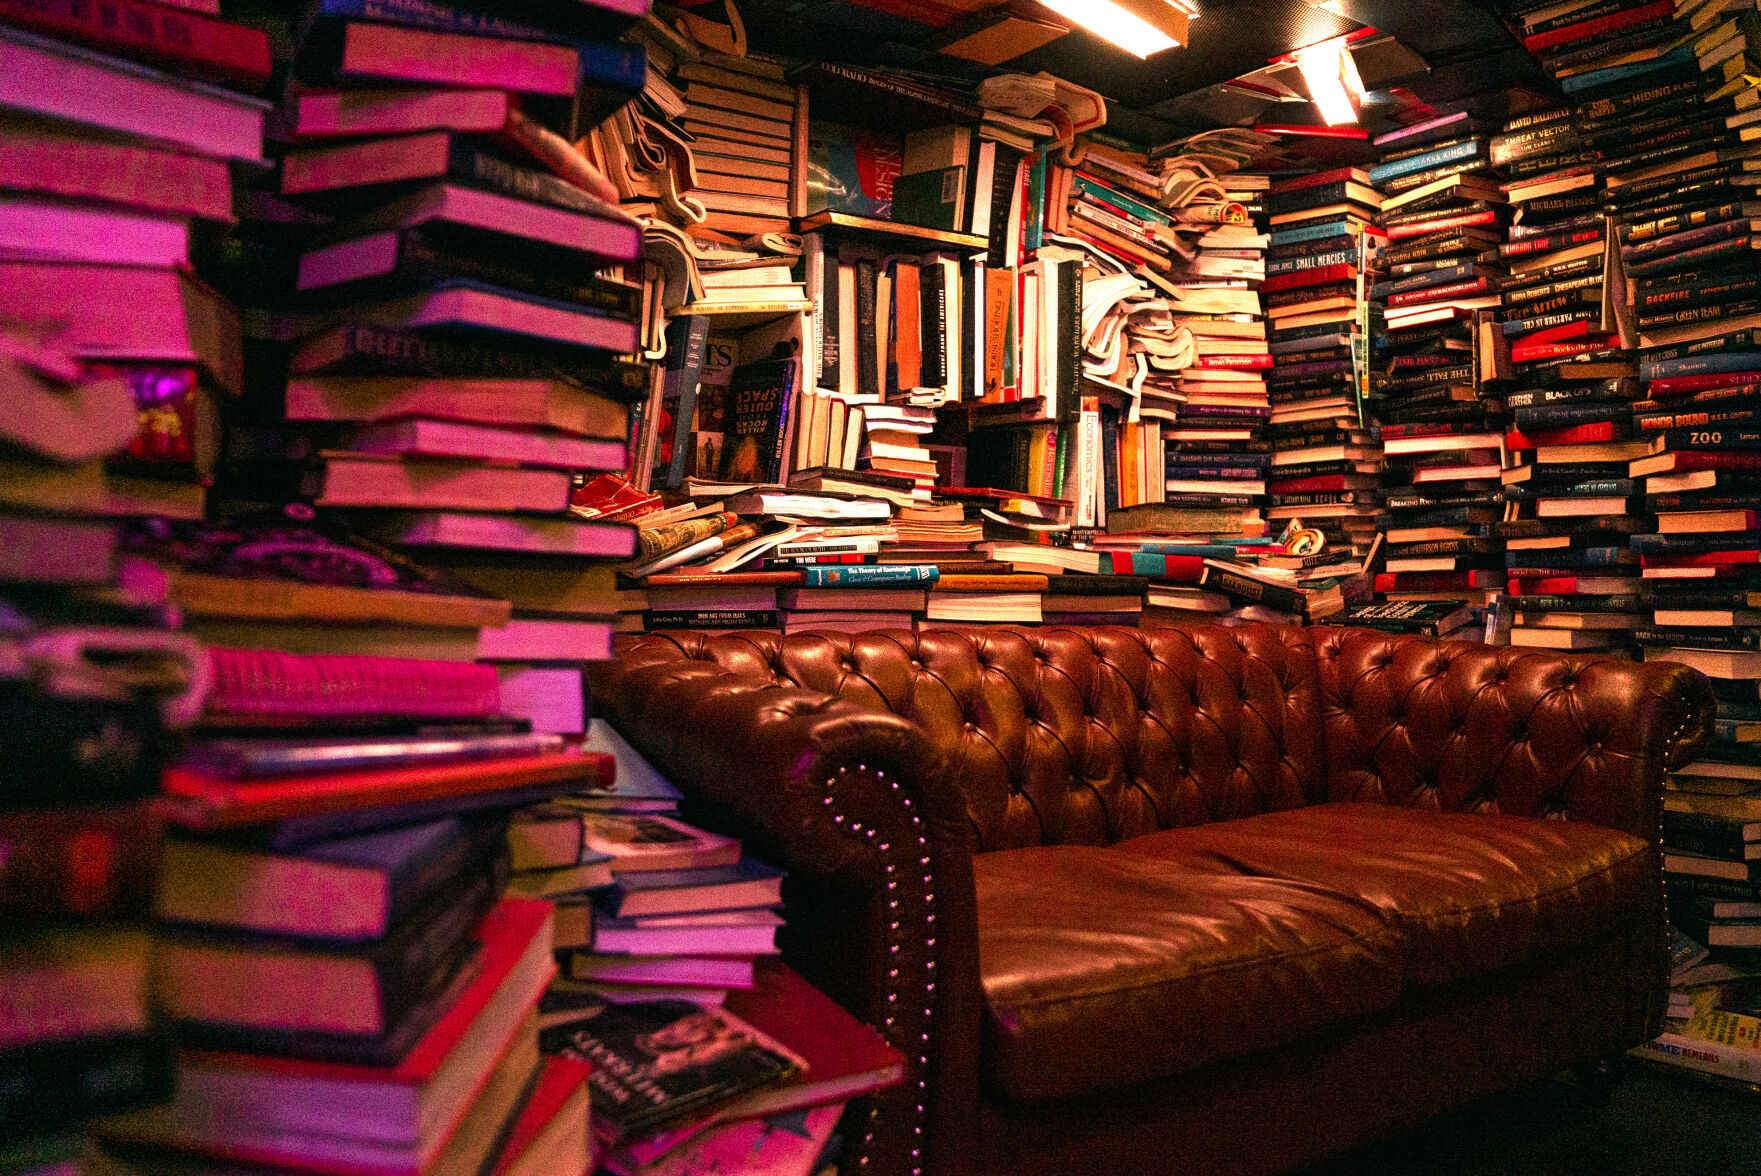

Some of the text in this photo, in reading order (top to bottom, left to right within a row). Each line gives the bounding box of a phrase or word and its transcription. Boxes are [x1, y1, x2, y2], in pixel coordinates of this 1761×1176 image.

[819, 60, 867, 83] COLORADO
[1631, 85, 1672, 104] HIDING
[1508, 107, 1570, 128] DAVID BALDACCI
[1504, 124, 1570, 145] THREAT VECTOR
[1533, 139, 1555, 147] CLANCY
[1442, 147, 1463, 159] KING
[1295, 256, 1315, 269] SMALL
[1316, 251, 1346, 266] MERCIES
[1510, 274, 1604, 301] NORA ROBERTS CHESAPEAKE BLUE
[1645, 289, 1691, 304] BACKFIRE
[1543, 313, 1572, 325] PARTNER
[1674, 304, 1720, 322] GREEN TEAM
[1522, 319, 1535, 329] CRI
[1534, 317, 1543, 327] IN
[1553, 343, 1586, 353] Rockville
[1208, 357, 1252, 366] James Patterson
[1398, 354, 1438, 366] THE FIRST
[1426, 368, 1469, 381] THE FALL
[736, 388, 779, 400] SPACE
[1545, 386, 1591, 400] BLACK OPS
[736, 401, 773, 413] OUTER
[736, 419, 768, 427] ROCKS
[1640, 416, 1673, 430] HONOR
[1674, 412, 1709, 427] BOUND
[1082, 414, 1097, 473] Economics
[1689, 430, 1759, 445] ZOO James
[773, 438, 784, 458] KILLER
[1390, 498, 1418, 507] BREAKING
[1419, 497, 1437, 505] POINT
